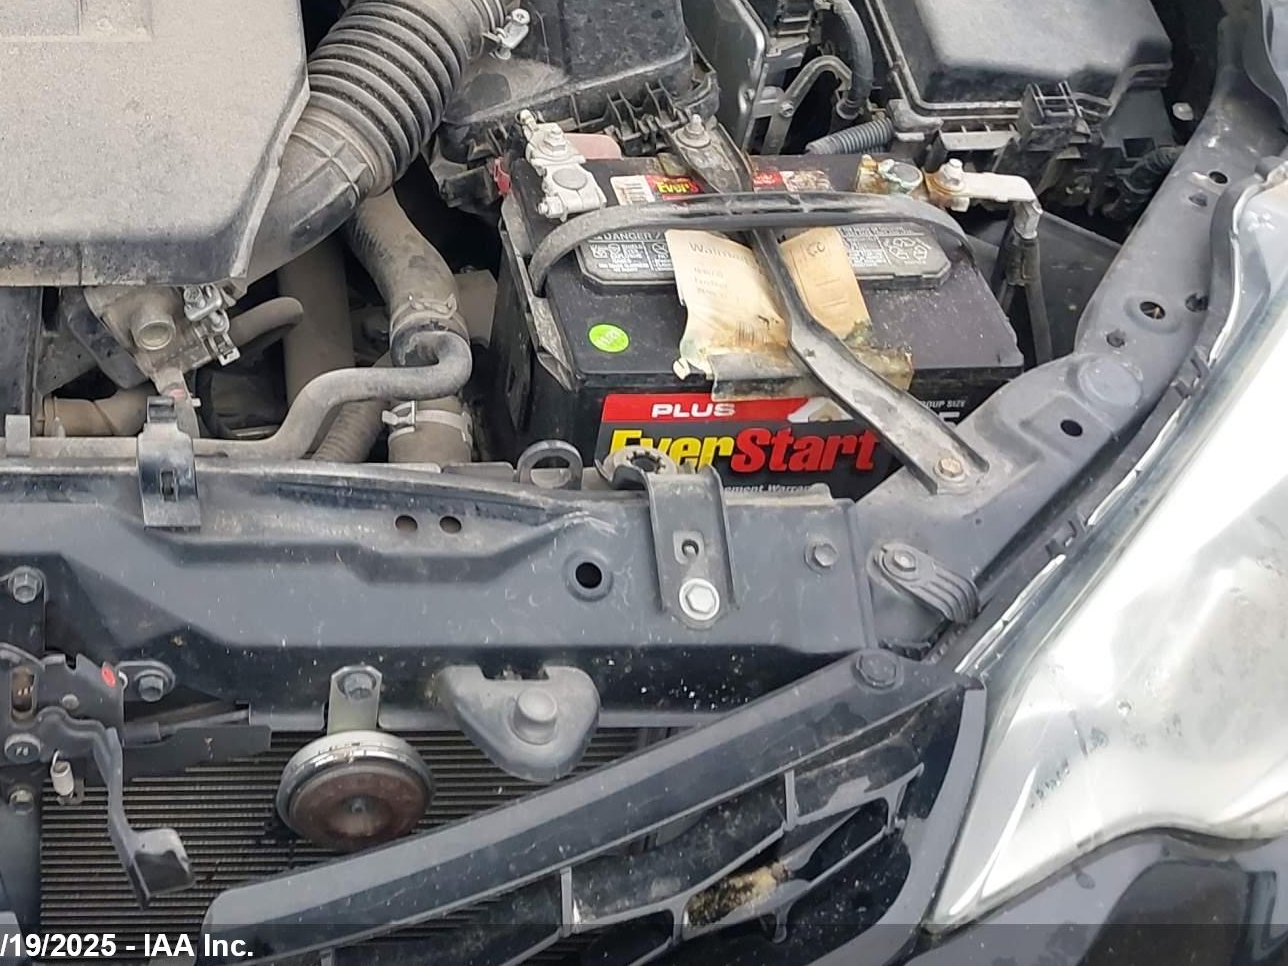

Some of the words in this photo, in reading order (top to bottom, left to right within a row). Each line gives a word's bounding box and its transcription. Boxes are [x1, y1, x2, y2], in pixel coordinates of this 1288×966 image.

[656, 179, 700, 194] EverS
[650, 402, 736, 419] PLUS
[724, 484, 764, 493] ement
